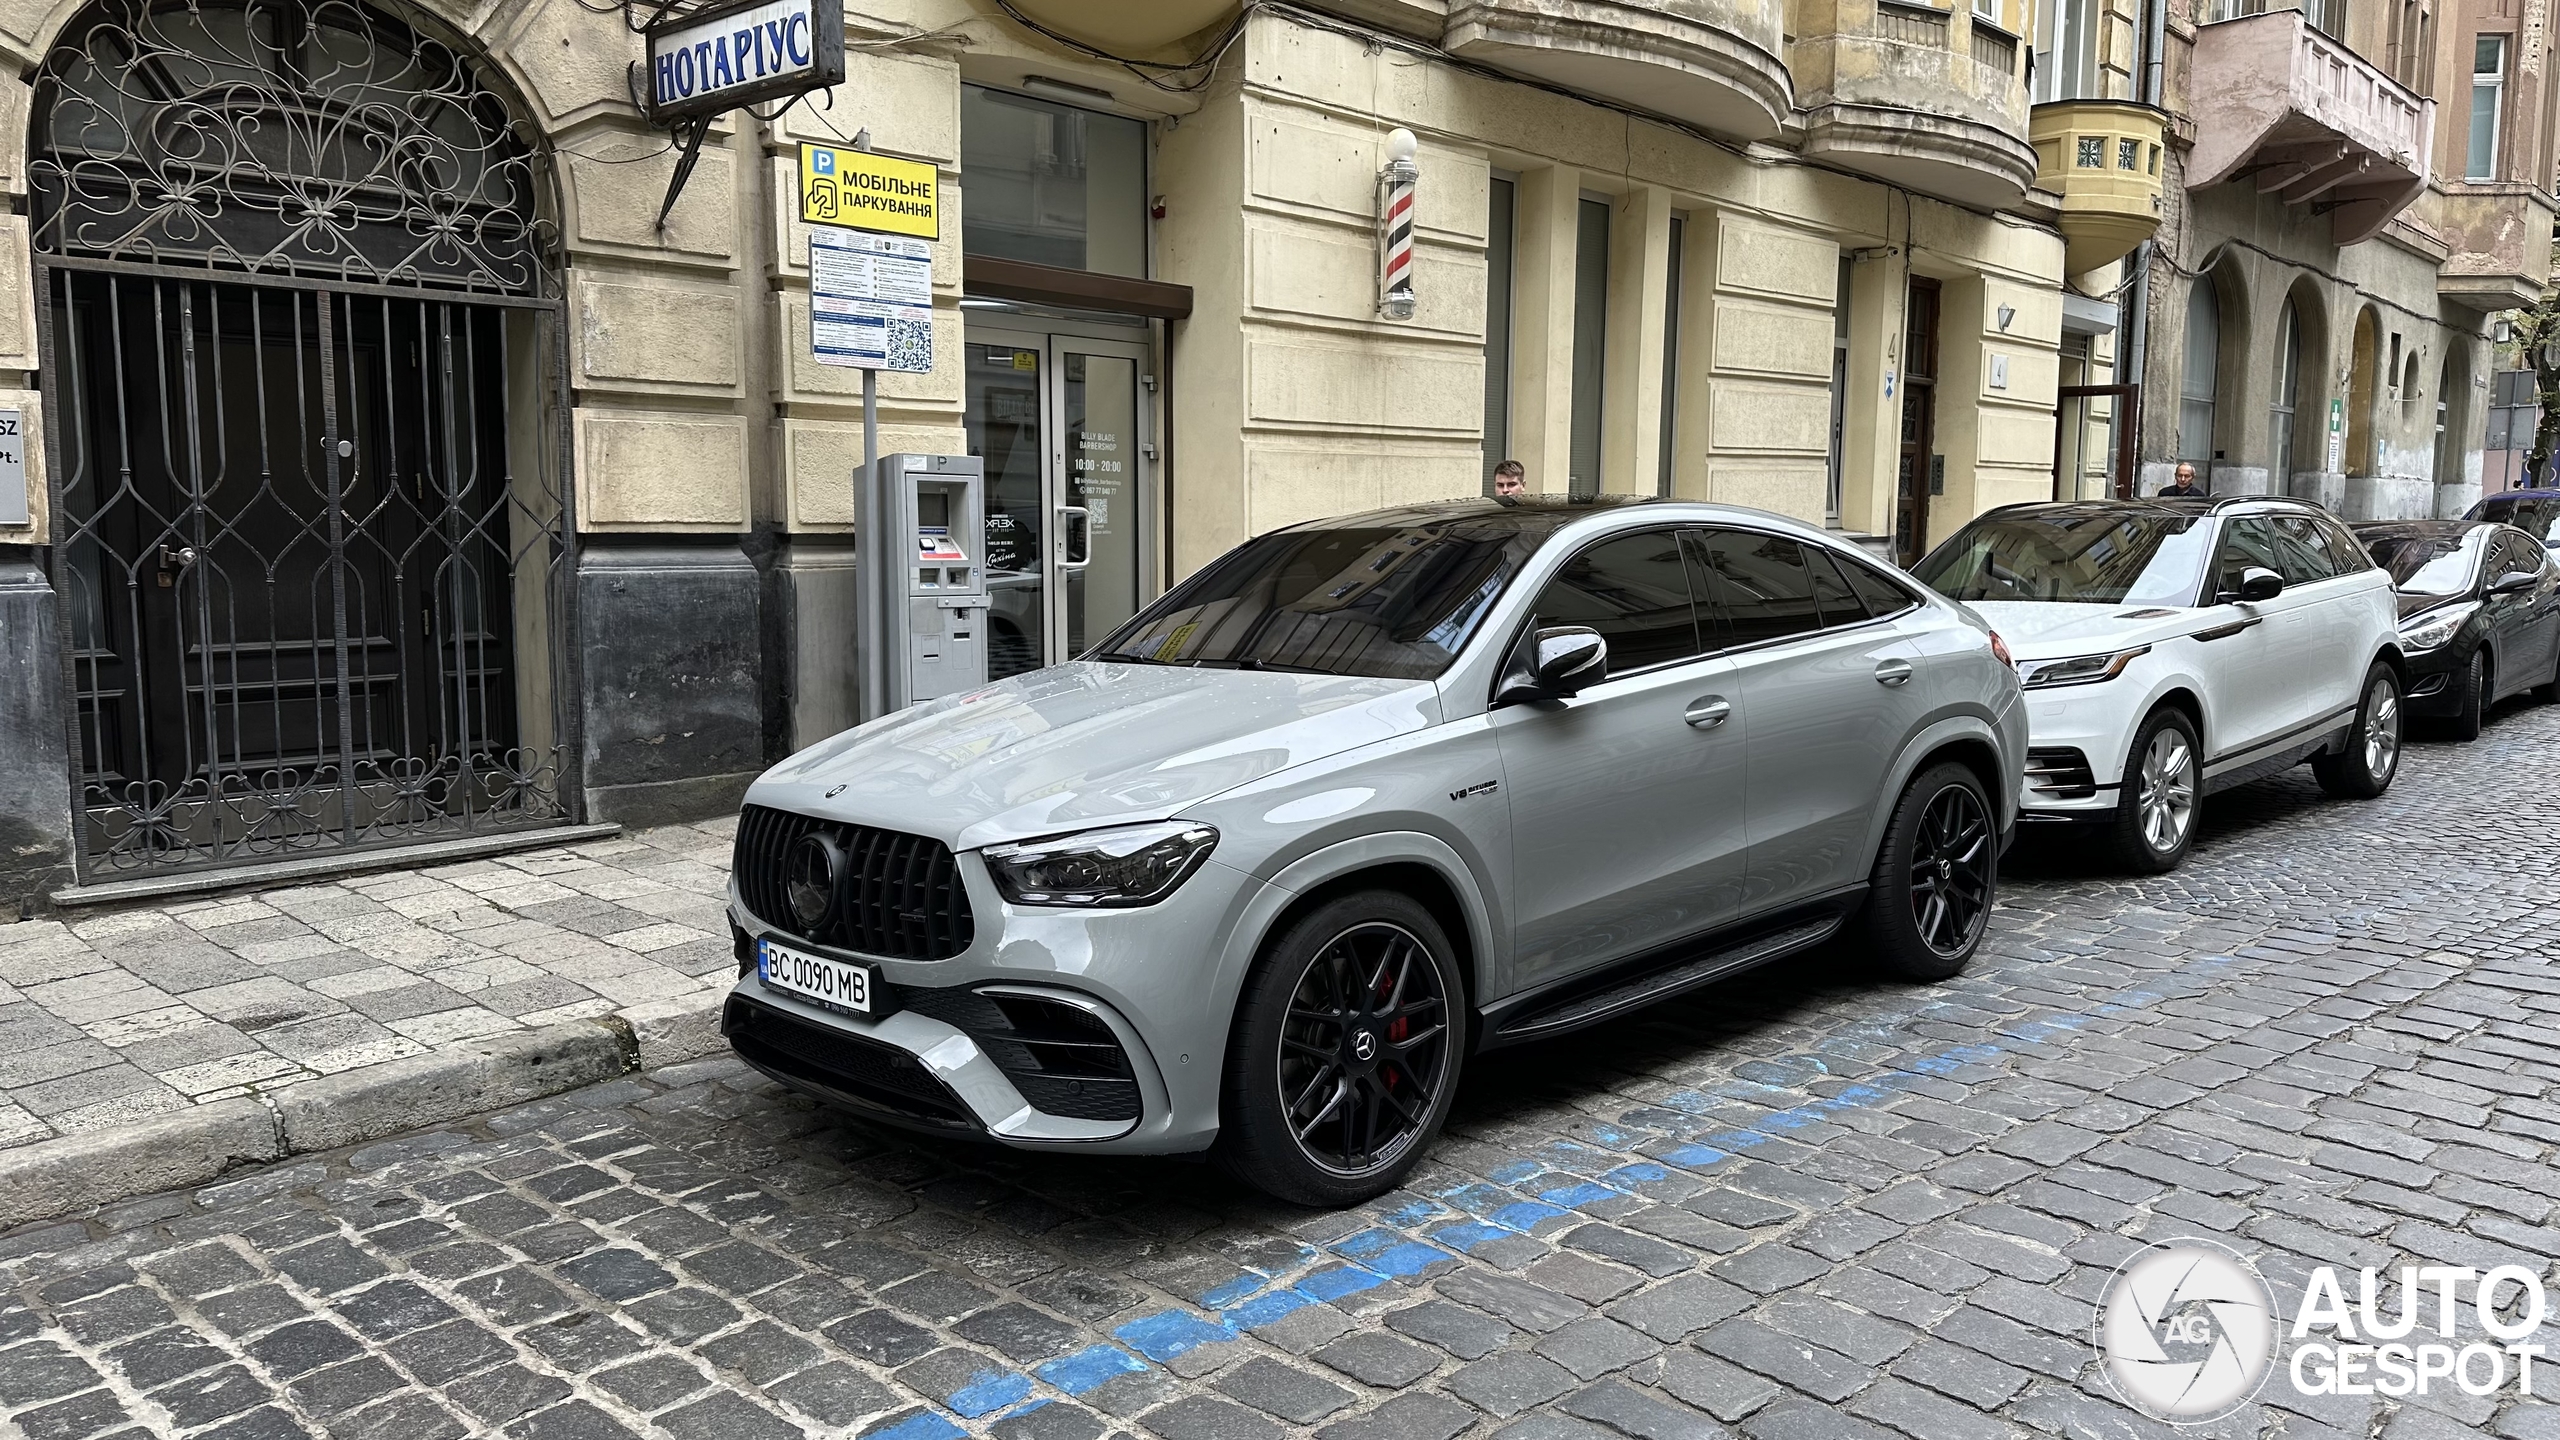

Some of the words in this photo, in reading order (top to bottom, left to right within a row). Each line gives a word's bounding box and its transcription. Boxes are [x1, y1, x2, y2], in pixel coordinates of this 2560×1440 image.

[656, 11, 810, 104] НОТАРІУС
[818, 152, 831, 171] P
[843, 170, 931, 199] МОБІЛЬНЕ
[843, 192, 932, 218] ПАРКУВАННЯ
[1888, 333, 1896, 364] 4
[1080, 441, 1117, 451] BARBERSHOP
[1081, 432, 1096, 440] BILLY
[1097, 433, 1115, 441] BLADE
[937, 456, 947, 470] P
[1075, 458, 1095, 470] 10:00
[1101, 460, 1121, 472] 20:00
[1449, 789, 1467, 801] V8
[769, 948, 791, 982] BC
[794, 957, 833, 995] 0090
[838, 968, 866, 1004] MB
